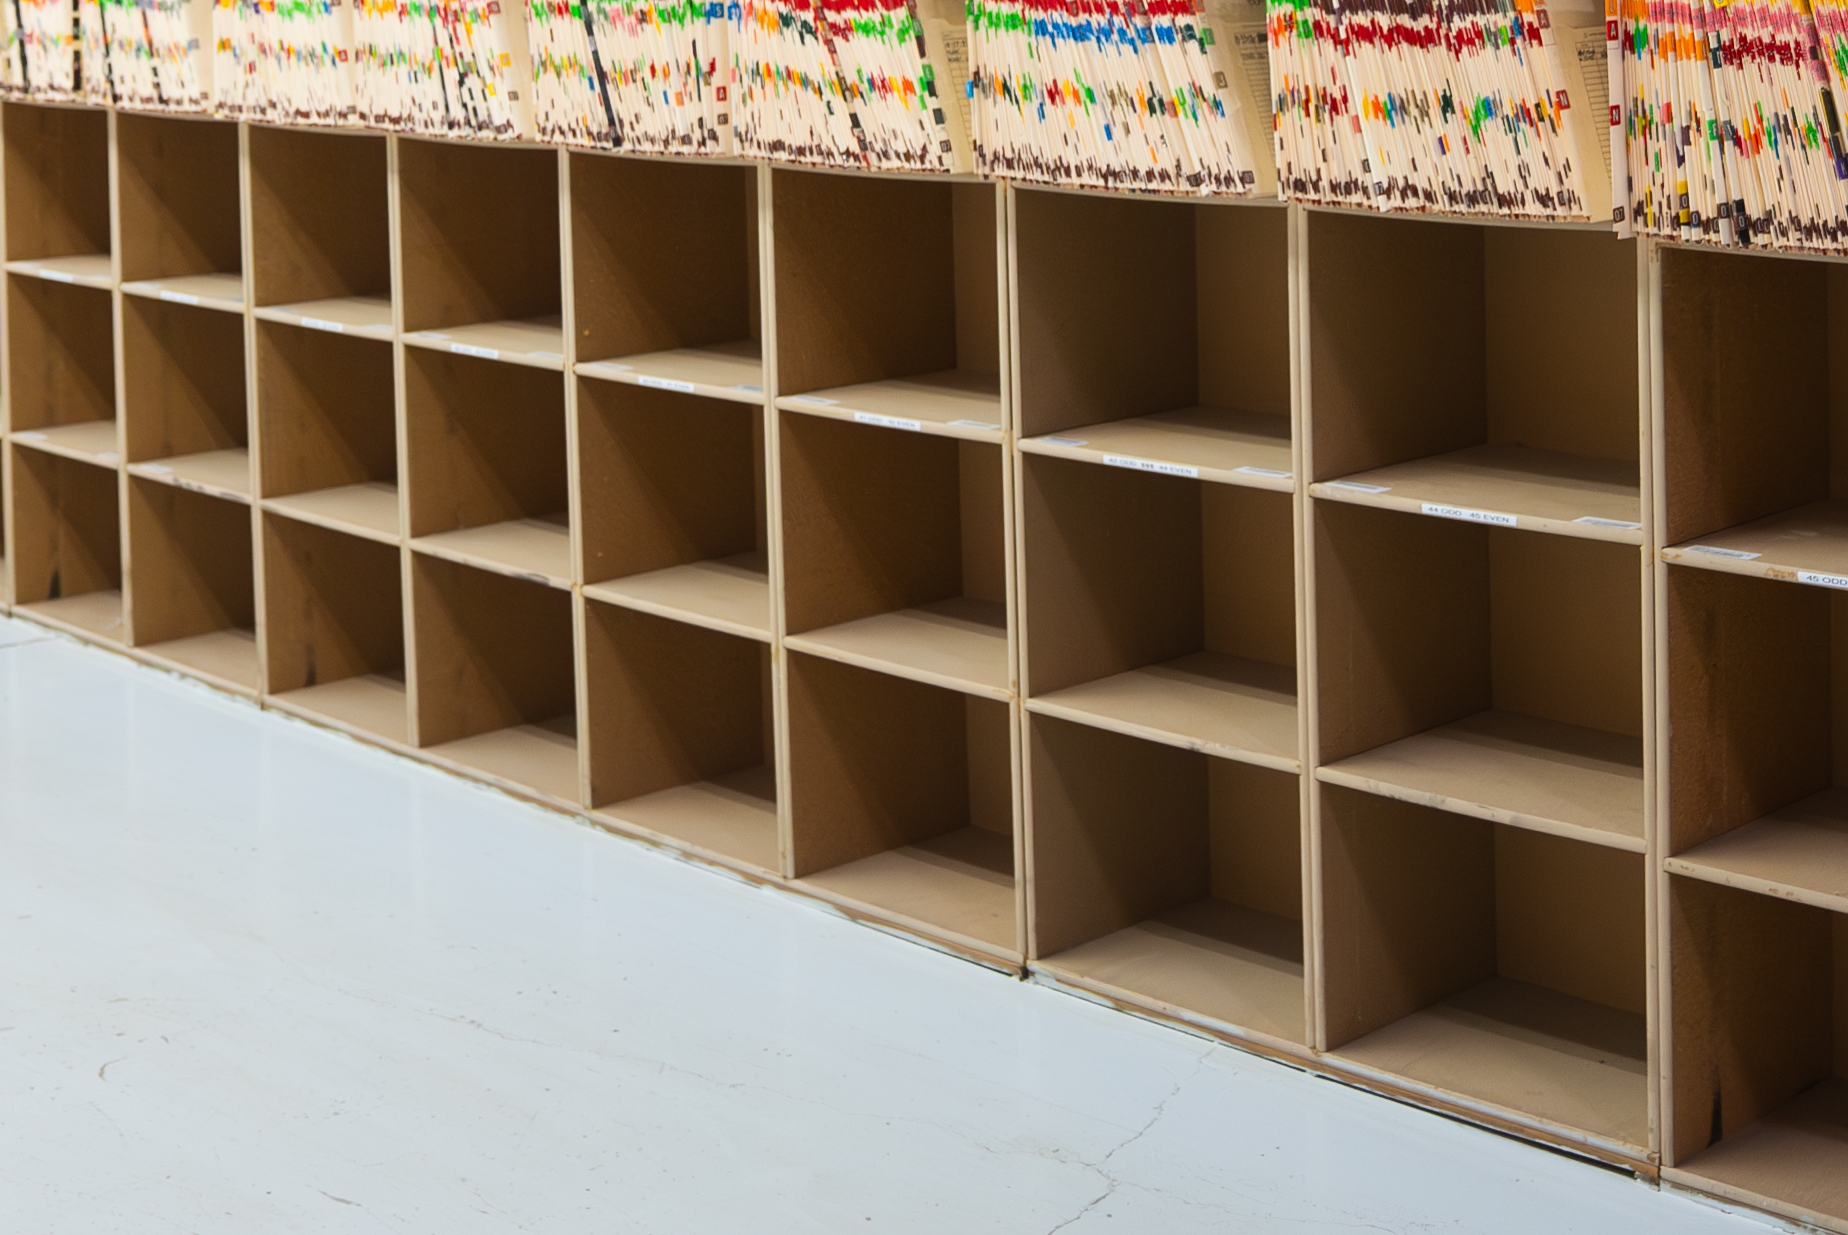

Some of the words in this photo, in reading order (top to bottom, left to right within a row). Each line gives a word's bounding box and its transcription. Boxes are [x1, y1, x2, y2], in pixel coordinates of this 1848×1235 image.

[1609, 22, 1617, 38] A
[1539, 12, 1546, 27] A
[1559, 92, 1568, 107] N
[1611, 107, 1619, 122] N
[1612, 208, 1624, 221] 07
[1169, 467, 1193, 476] EVEN
[1427, 506, 1439, 514] 44
[1440, 508, 1463, 517] ODD
[1468, 511, 1482, 520] 45
[1482, 514, 1511, 524] EVEN
[1805, 575, 1820, 583] 45
[1821, 577, 1848, 587] ODD
